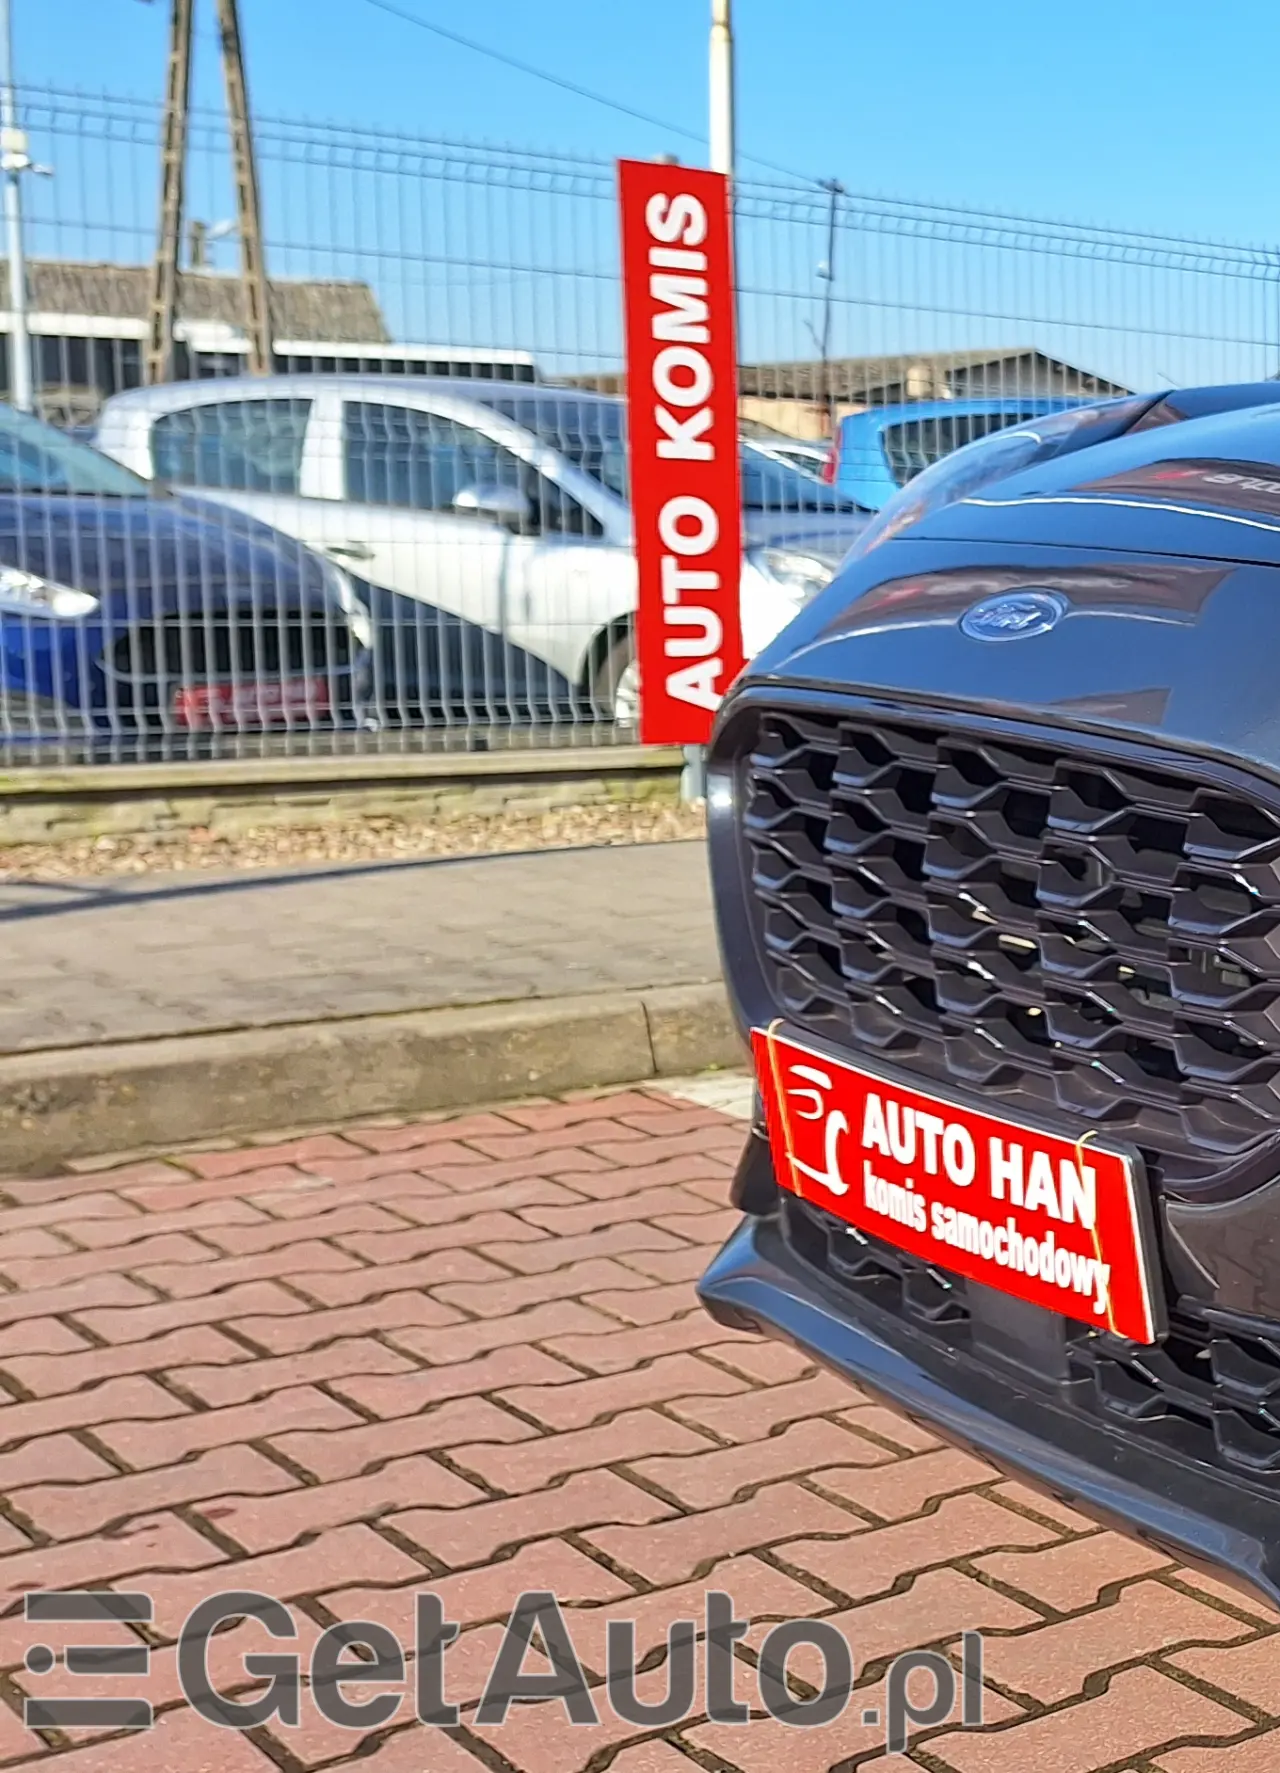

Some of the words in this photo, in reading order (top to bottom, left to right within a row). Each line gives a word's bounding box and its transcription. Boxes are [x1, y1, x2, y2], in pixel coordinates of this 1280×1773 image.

[645, 191, 717, 463] KOMIS
[659, 493, 724, 714] AUTO
[861, 1092, 976, 1187] AUTO
[988, 1137, 1097, 1231] HAN
[863, 1159, 927, 1233] komis
[930, 1200, 1112, 1316] samochodowy
